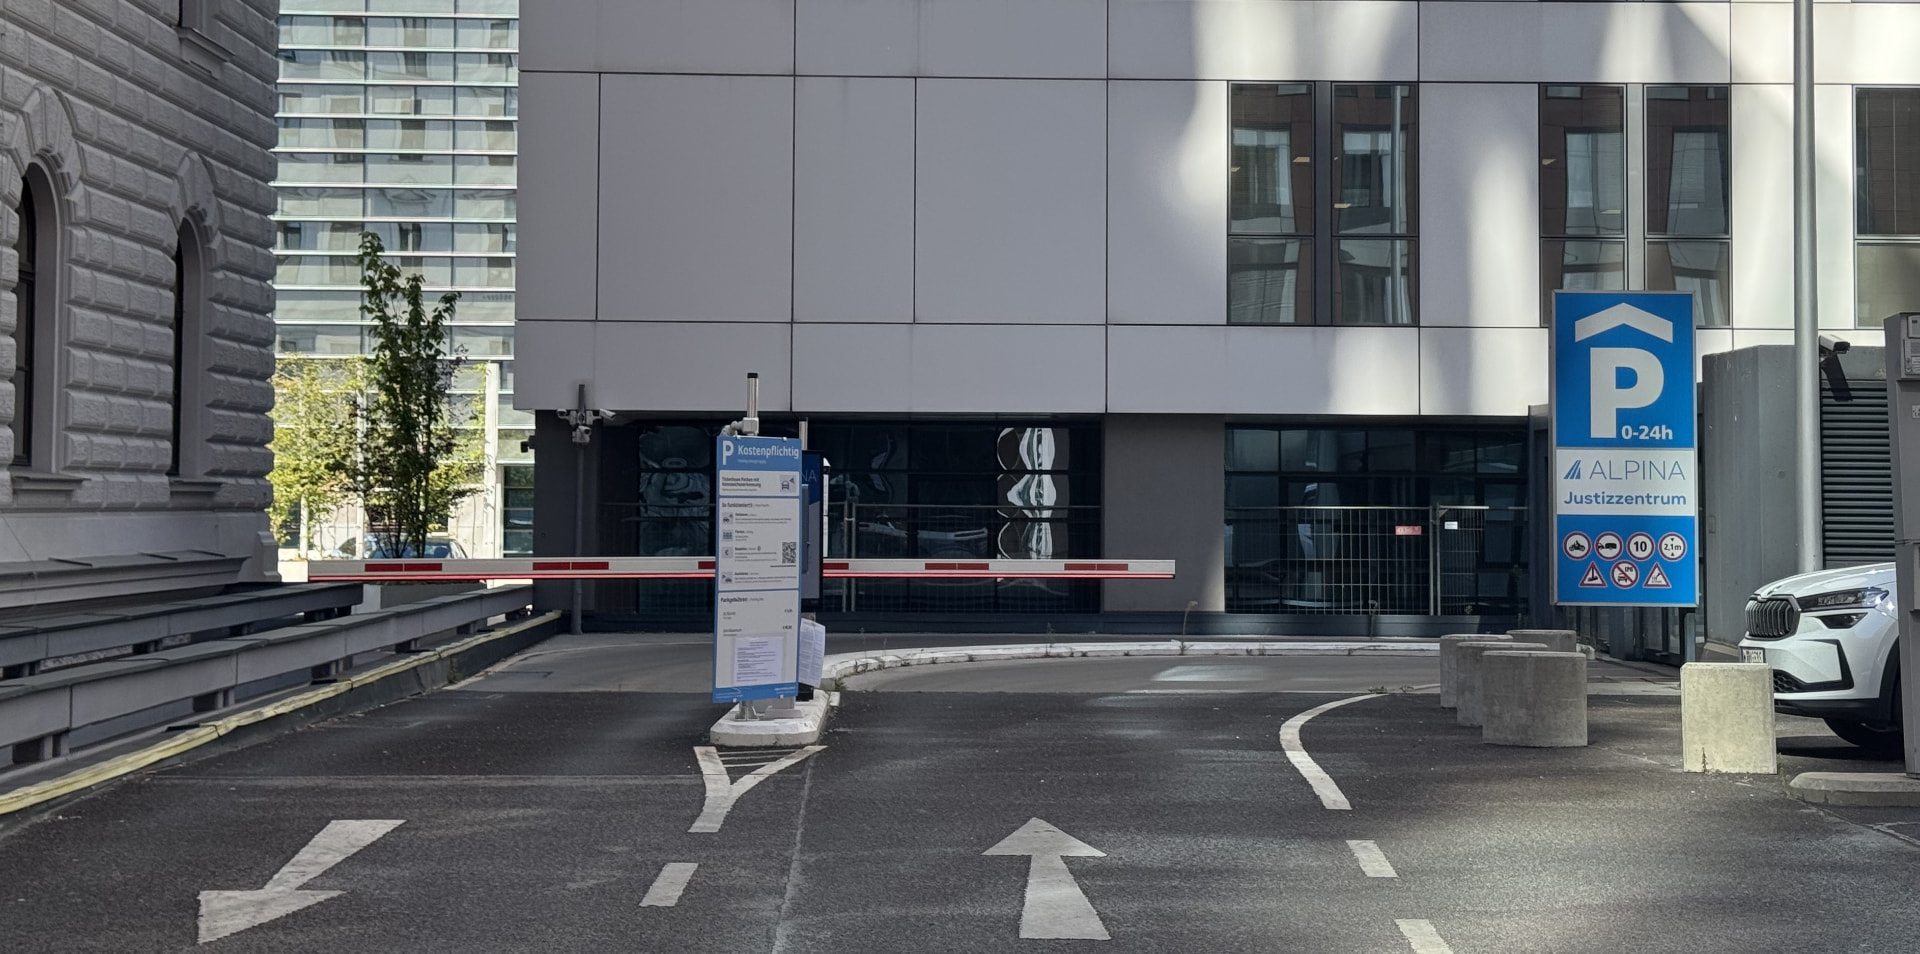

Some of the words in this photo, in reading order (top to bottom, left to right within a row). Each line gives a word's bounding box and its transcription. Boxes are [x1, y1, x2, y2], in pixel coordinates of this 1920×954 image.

[1590, 347, 1664, 438] P
[1621, 425, 1673, 440] 0-24h
[722, 440, 734, 465] P
[738, 445, 799, 460] Kostenpflichtig
[1589, 460, 1686, 480] ALPINA
[1563, 491, 1687, 505] Justizzentrum
[1634, 541, 1647, 552] 10
